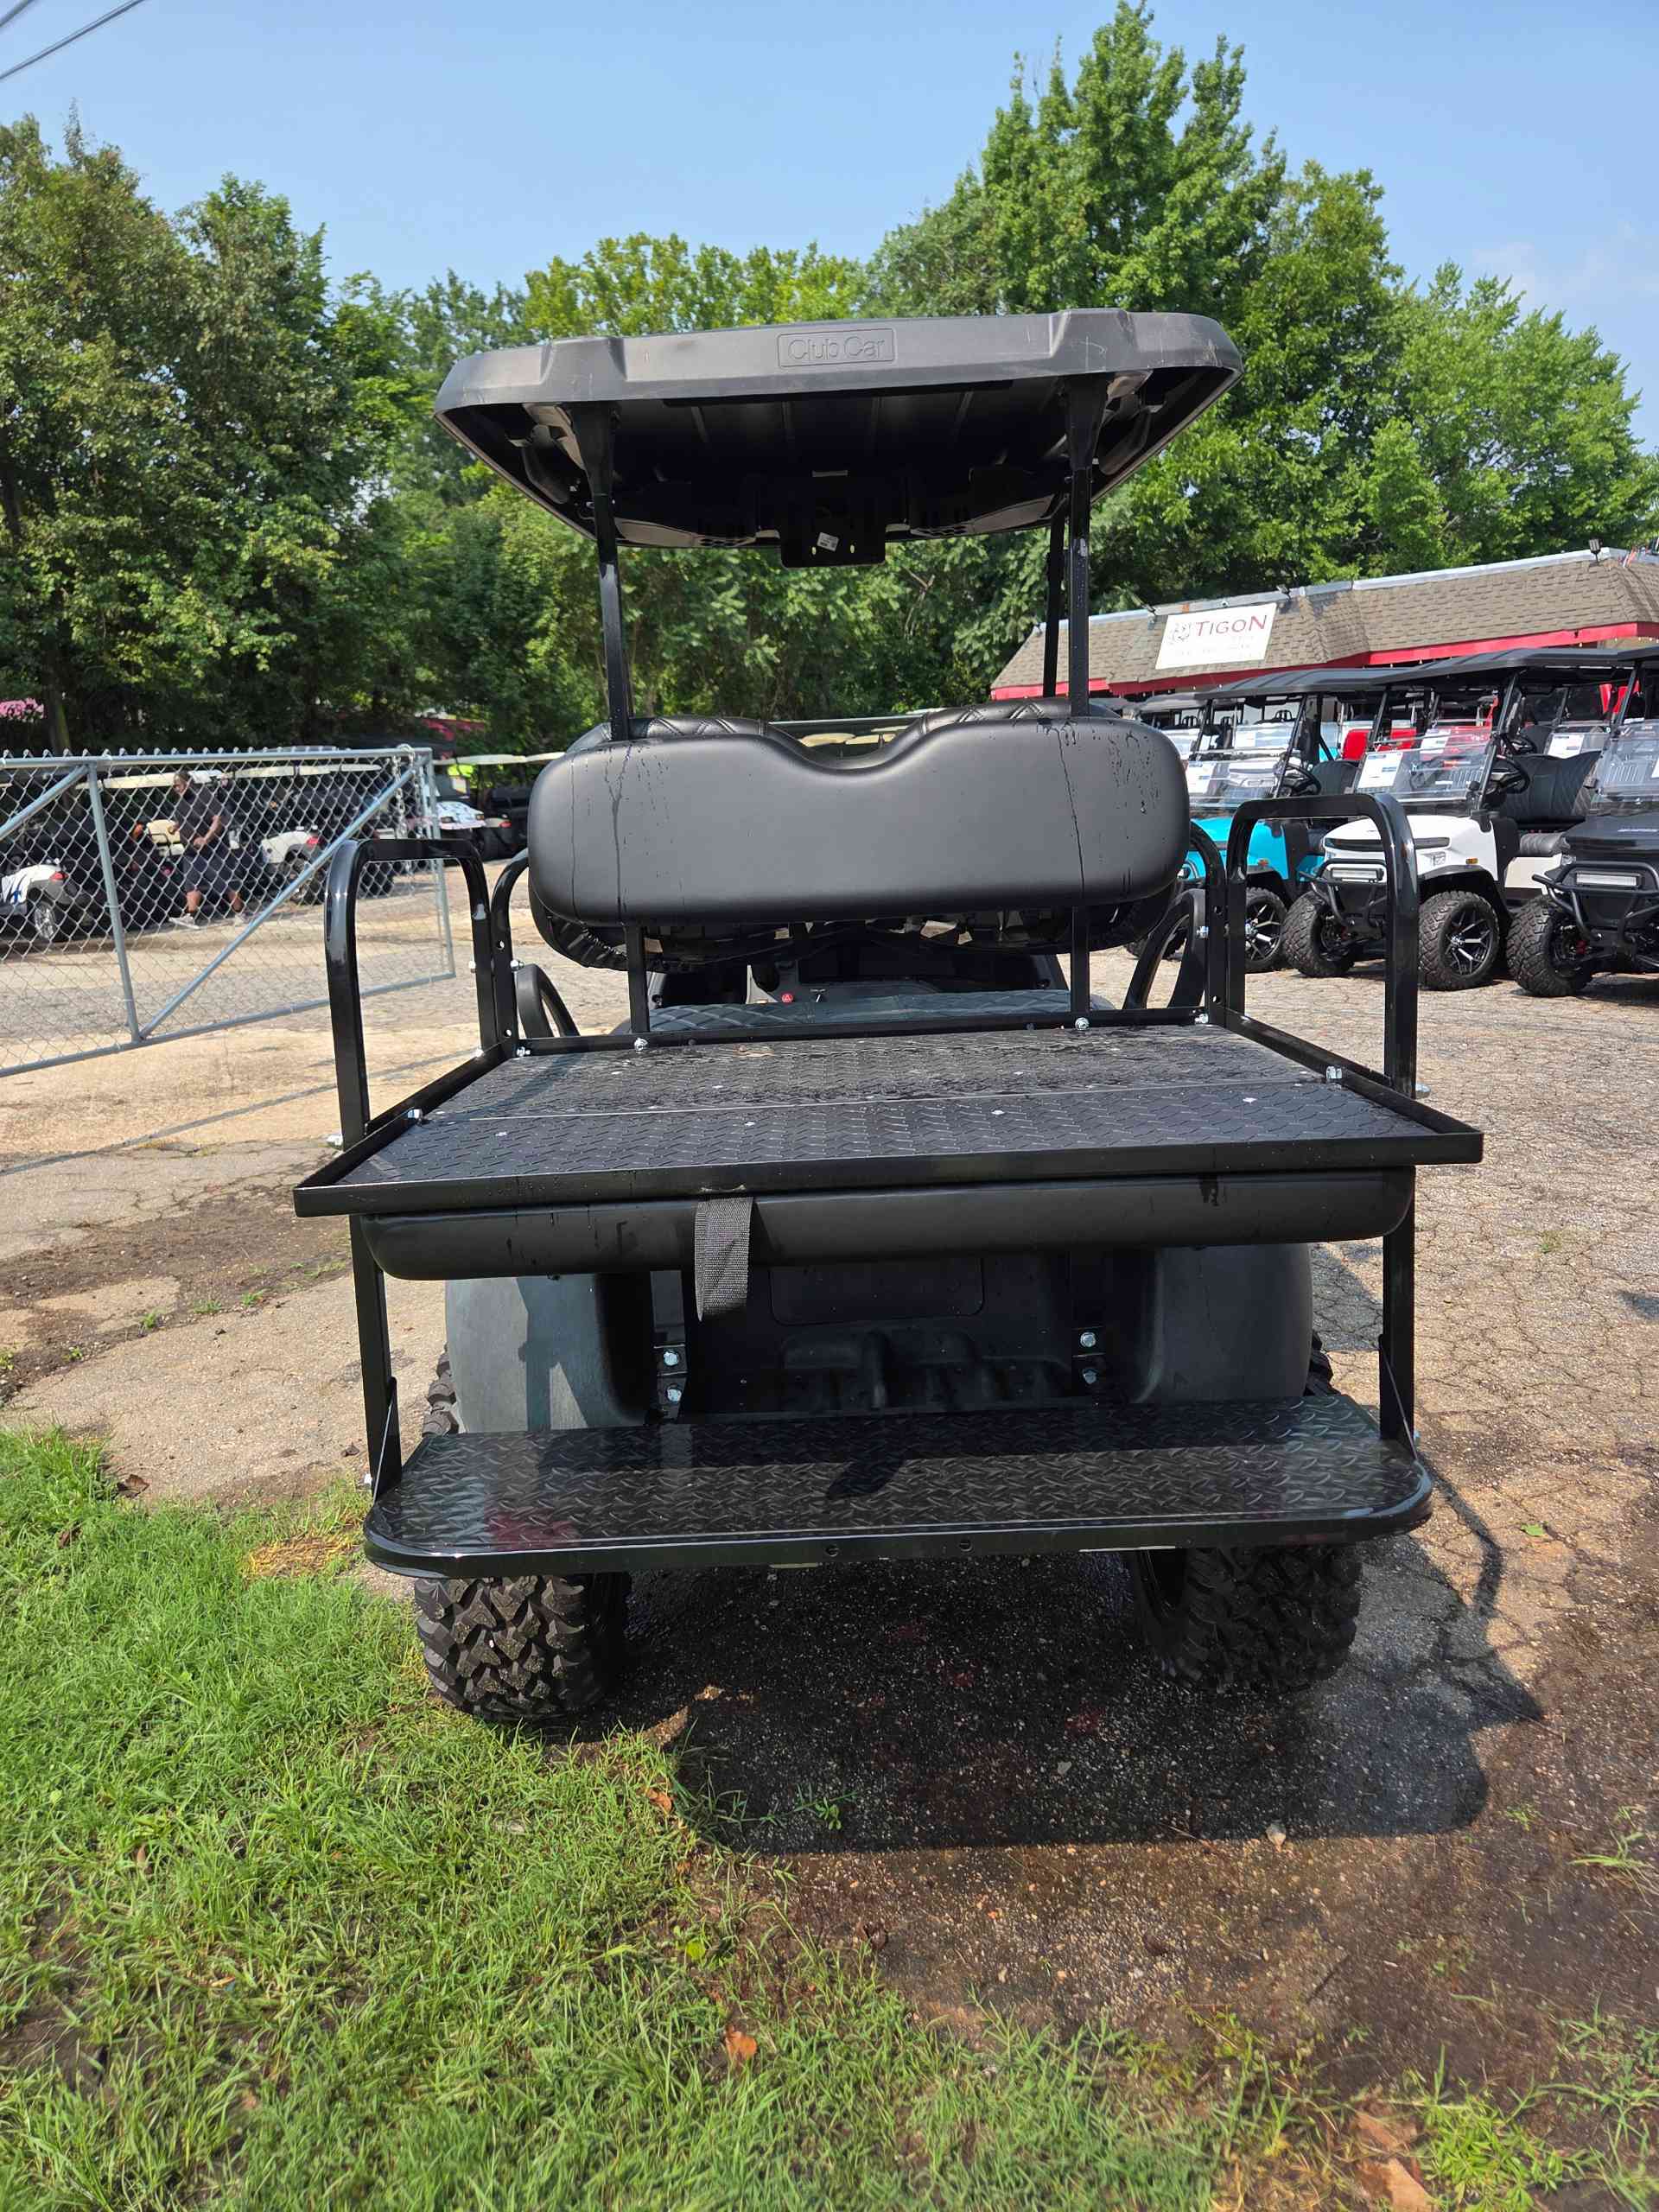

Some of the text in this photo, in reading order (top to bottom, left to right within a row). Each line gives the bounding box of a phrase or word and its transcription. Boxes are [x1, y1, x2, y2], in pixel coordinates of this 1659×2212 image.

[788, 336, 885, 360] Club Car
[1196, 615, 1267, 637] TIGON
